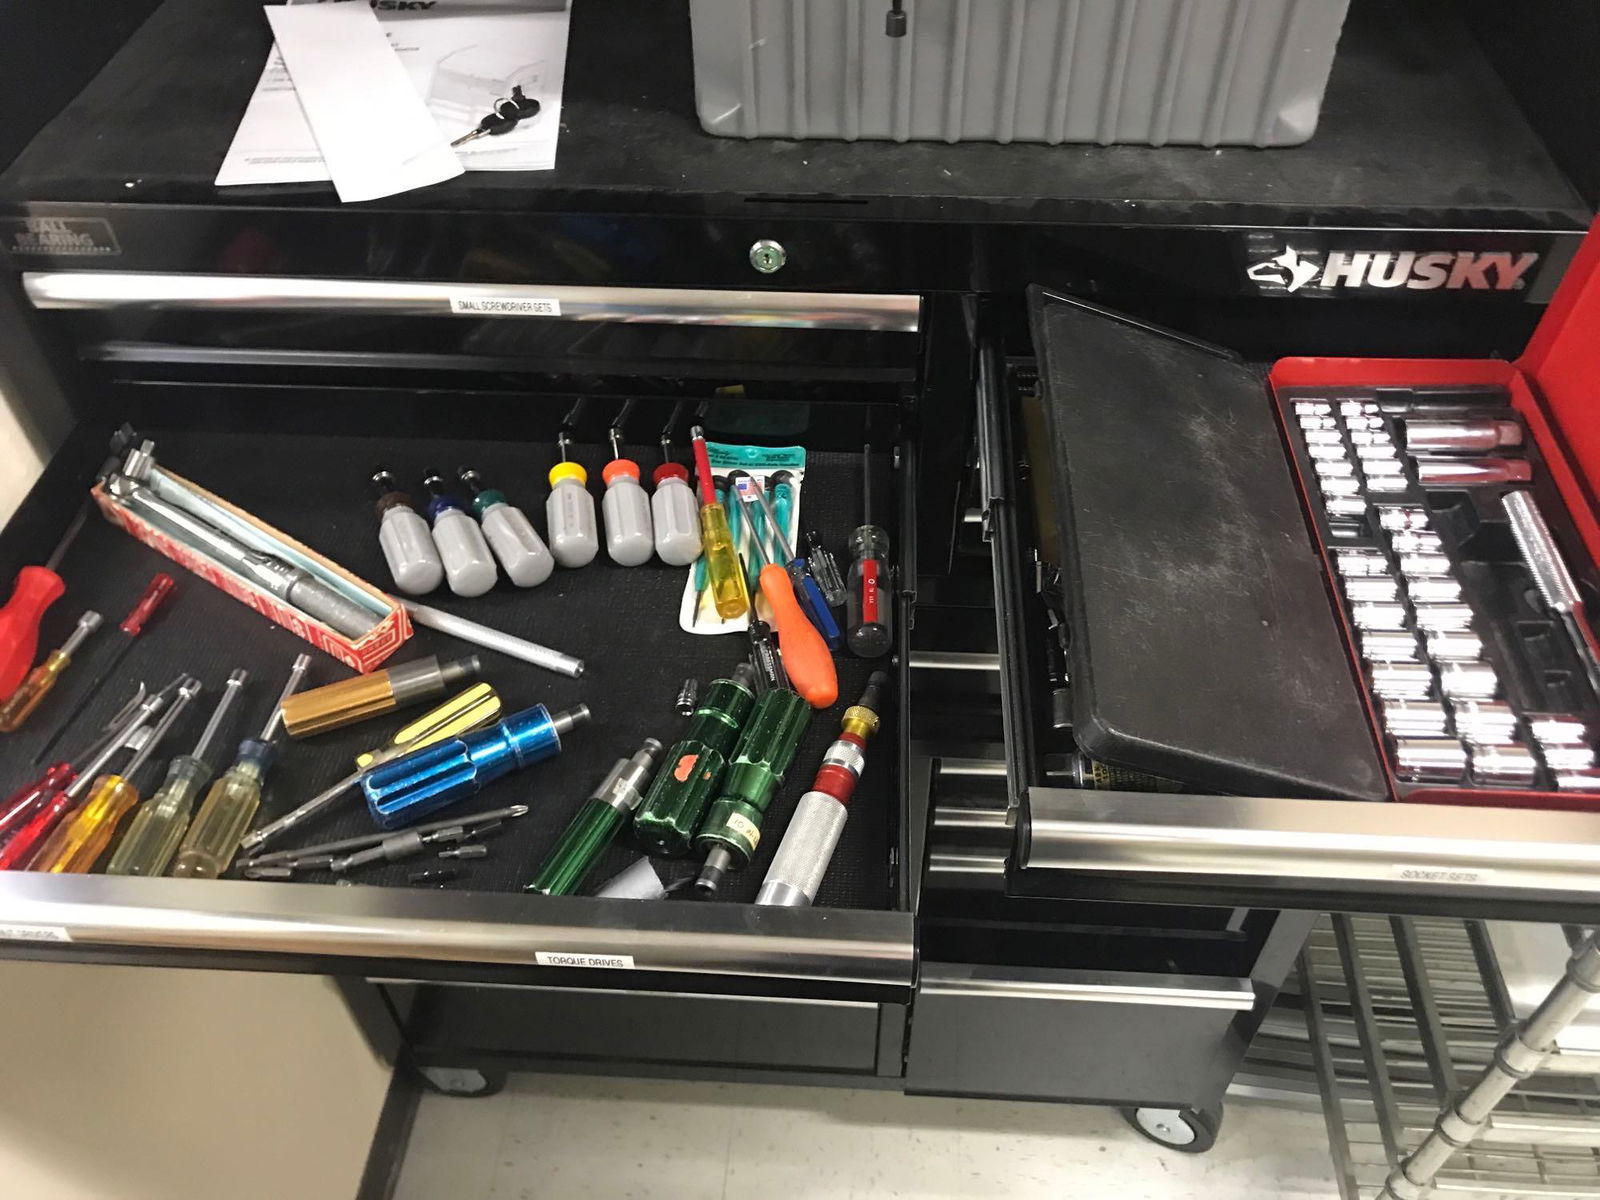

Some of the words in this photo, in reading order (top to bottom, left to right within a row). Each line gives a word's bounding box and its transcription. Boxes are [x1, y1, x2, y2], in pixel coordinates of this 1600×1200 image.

[1320, 251, 1538, 290] HUSKY
[458, 301, 481, 310] SMALL
[482, 301, 532, 312] SCREWDRIVER
[534, 303, 552, 312] SETS
[1400, 870, 1447, 881] SOCKET
[1449, 872, 1478, 882] SETS
[547, 956, 586, 967] TORQUE
[588, 957, 624, 968] DRIVES
